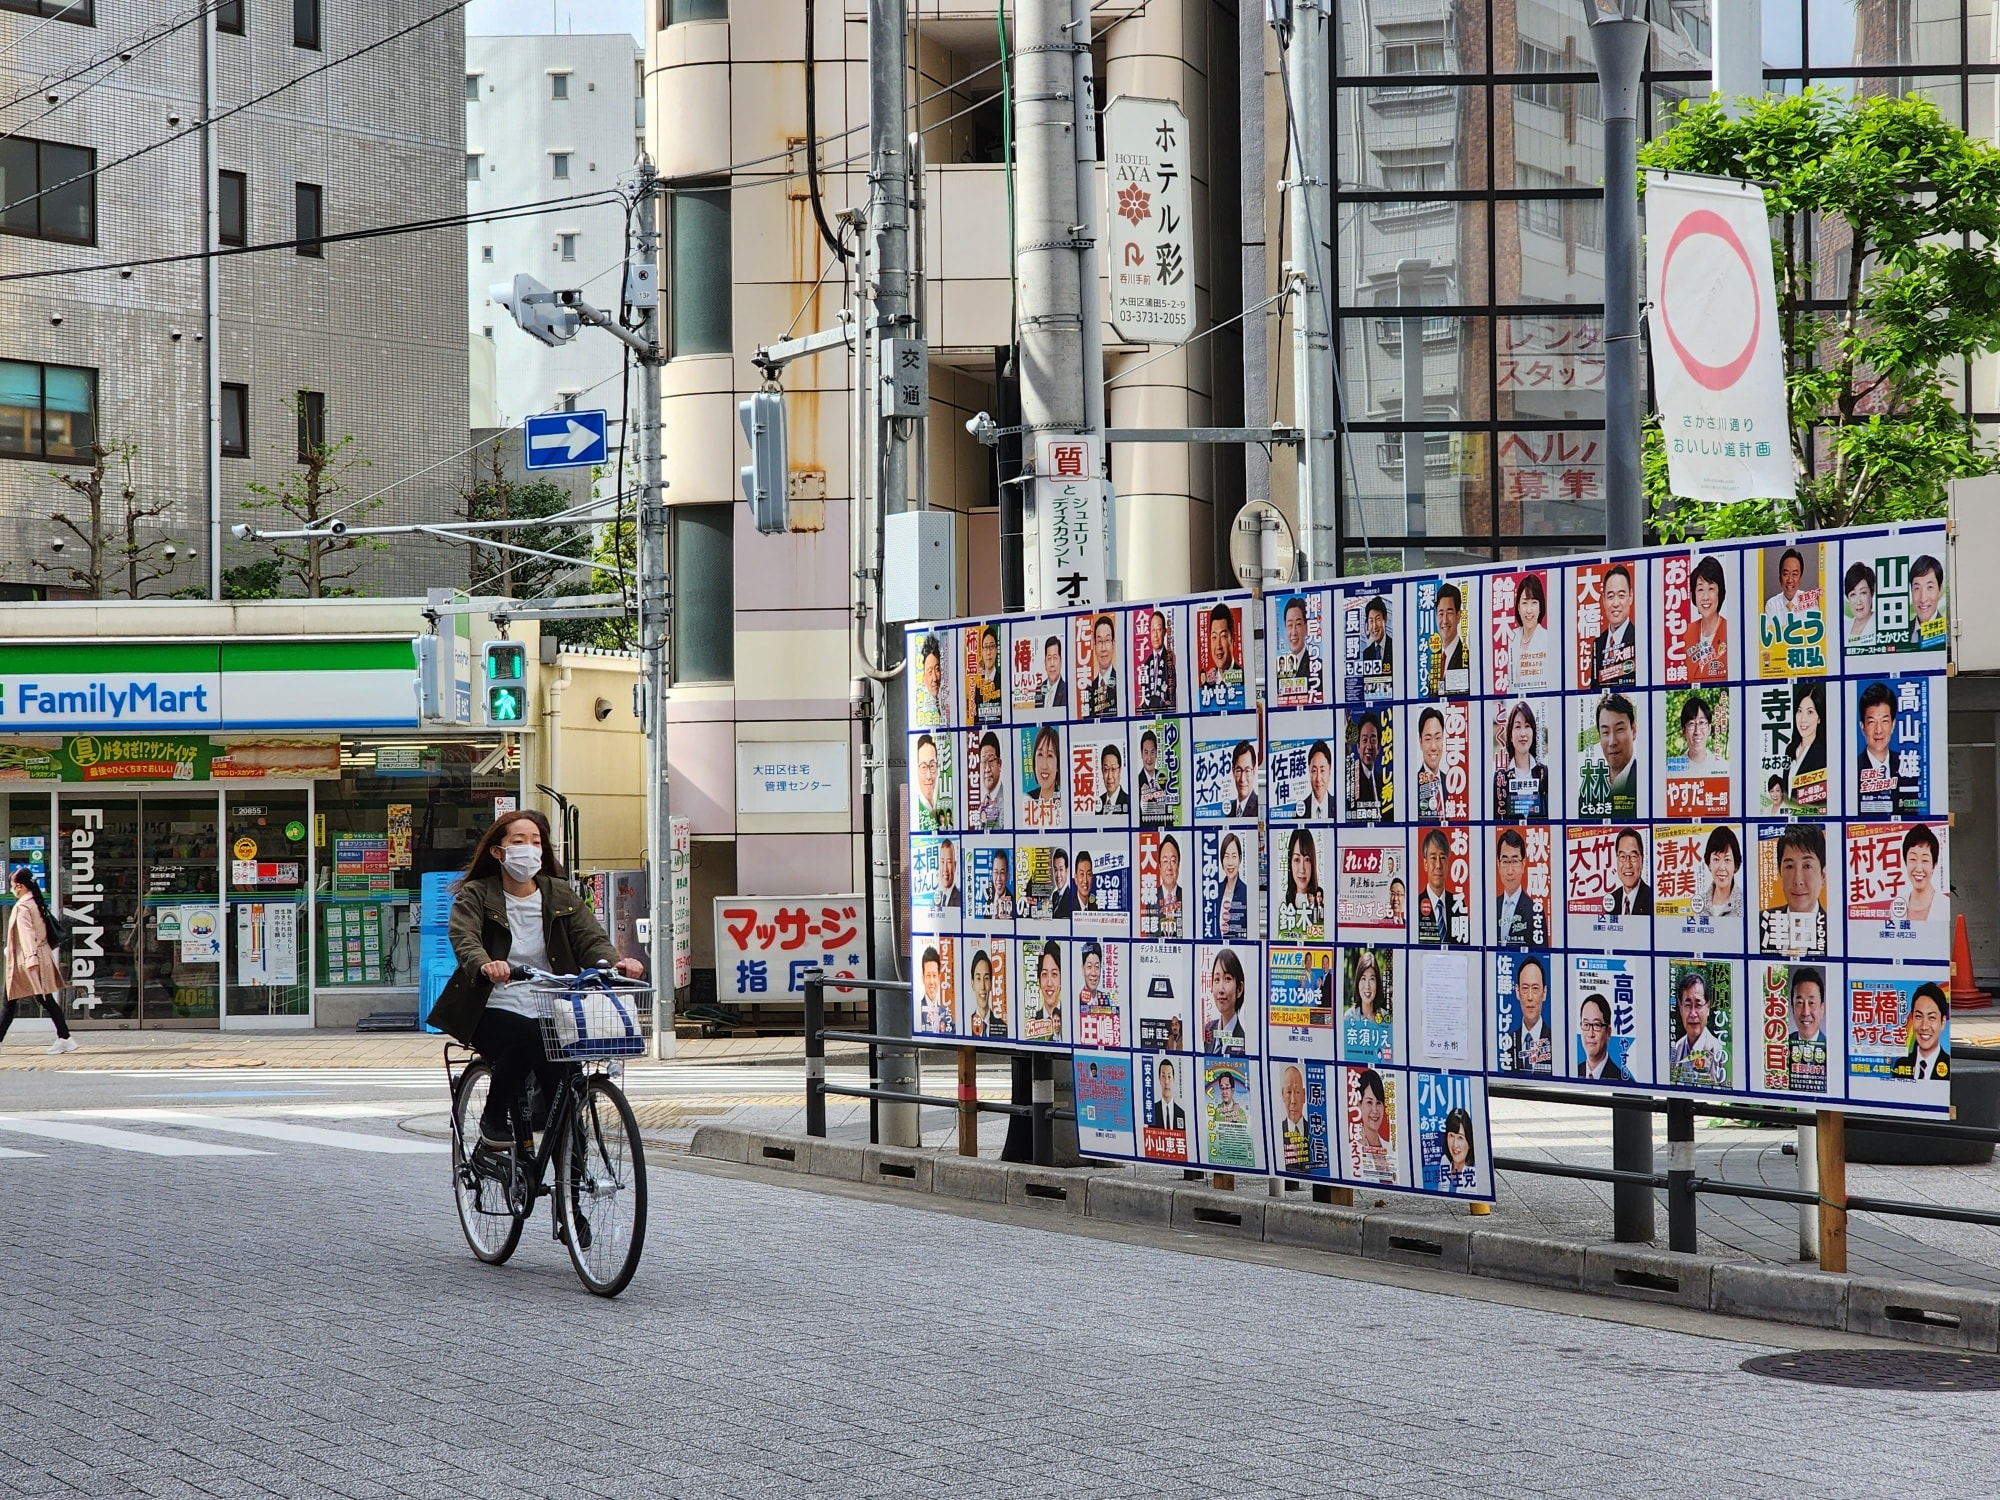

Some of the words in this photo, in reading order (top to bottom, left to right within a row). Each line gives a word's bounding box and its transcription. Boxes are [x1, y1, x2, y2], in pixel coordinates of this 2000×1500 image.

[1115, 153, 1151, 166] HOTEL
[1116, 166, 1151, 183] AYA
[1155, 118, 1185, 287] ホテル彩
[1120, 310, 1187, 325] 03-3731-2055
[902, 348, 920, 405] 交通
[1683, 415, 1754, 432] さかさ川通り
[1055, 447, 1082, 476] 質
[1674, 438, 1771, 458] おいしい道計画
[1064, 484, 1076, 495] と
[1508, 469, 1599, 499] 募集
[1052, 498, 1070, 568] ディスカウント
[1073, 498, 1089, 556] ジュエリー
[1876, 558, 1909, 630] 山田
[1665, 559, 1688, 661] おかもと
[1346, 609, 1361, 660] 長野
[1493, 576, 1515, 691] 鈴木ゆみ
[1577, 568, 1601, 687] 大橋たけし
[1760, 610, 1825, 648] いとう
[1876, 631, 1910, 643] たかひさ
[1014, 638, 1032, 673] 椿
[1346, 660, 1382, 676] もとひろ
[1382, 663, 1391, 673] 39
[1787, 647, 1825, 669] 和弘
[1013, 673, 1044, 687] しんいち
[1667, 665, 1688, 681] 由美
[18, 683, 208, 718] FamilyMart
[1761, 688, 1791, 755] 寺下
[1445, 704, 1467, 795] あまの
[1897, 681, 1920, 793] 高山雄一
[90, 761, 173, 777] 最後のひとくちまでおいしい
[753, 764, 810, 775] 大田区住宅
[1073, 748, 1095, 798] 天坂
[1164, 722, 1180, 796] ゆもと
[1195, 750, 1232, 783] あらお
[1270, 749, 1307, 783] 佐藤
[1761, 756, 1792, 770] なおみ
[1861, 768, 1886, 780] 区政に
[765, 781, 832, 792] 管理センター
[1196, 782, 1222, 806] 大介
[1275, 781, 1290, 806] 伸
[1510, 780, 1538, 791] 国民民主党
[1580, 759, 1611, 803] 林
[238, 807, 262, 815] 20855
[1024, 798, 1055, 827] 北村
[1074, 797, 1095, 812] 大介
[1445, 800, 1468, 818] 雄太
[1580, 802, 1613, 815] ともおき
[913, 845, 940, 875] 本間
[1094, 853, 1125, 868] 立憲民主党
[1569, 836, 1615, 874] 大竹
[1656, 836, 1702, 871] 清水
[1849, 835, 1903, 875] 村石
[914, 872, 940, 893] けんじ
[975, 849, 990, 900] 三沢
[1096, 874, 1120, 889] ひらの
[1140, 837, 1158, 905] 大森
[1203, 833, 1219, 938] こみねよしえ
[1450, 828, 1469, 944] おのえ明
[1525, 827, 1550, 945] 秋成おさむ
[1569, 868, 1617, 898] たつじ
[1657, 869, 1697, 898] 菊美
[1849, 871, 1906, 902] まい子
[71, 808, 104, 1010] FamilyMart
[1279, 901, 1313, 932] 鈴木
[1355, 901, 1394, 919] かずとも
[723, 906, 858, 951] マッサージ
[1760, 909, 1818, 951] 津田
[1896, 931, 1917, 939] 4月23日
[1140, 944, 1182, 954] デジタル民主主義を
[1271, 952, 1303, 966] NHK党
[991, 954, 1003, 1019] つばさ
[1270, 987, 1287, 1003] おち
[1288, 988, 1323, 1005] ひろゆき
[972, 1017, 982, 1027] 29
[1497, 955, 1513, 1071] 佐藤しげゆき
[1765, 966, 1788, 1071] しおの目
[1851, 989, 1898, 1025] 馬橋
[1347, 1027, 1391, 1048] 奈須りえ
[1851, 1026, 1907, 1046] やすとき
[1143, 1063, 1153, 1123] 安全と幸せ
[1765, 1074, 1789, 1088] まさき
[1419, 1074, 1472, 1120] 小川
[1420, 1115, 1447, 1133] あずさ
[1145, 1135, 1187, 1155] 小山恵吾
